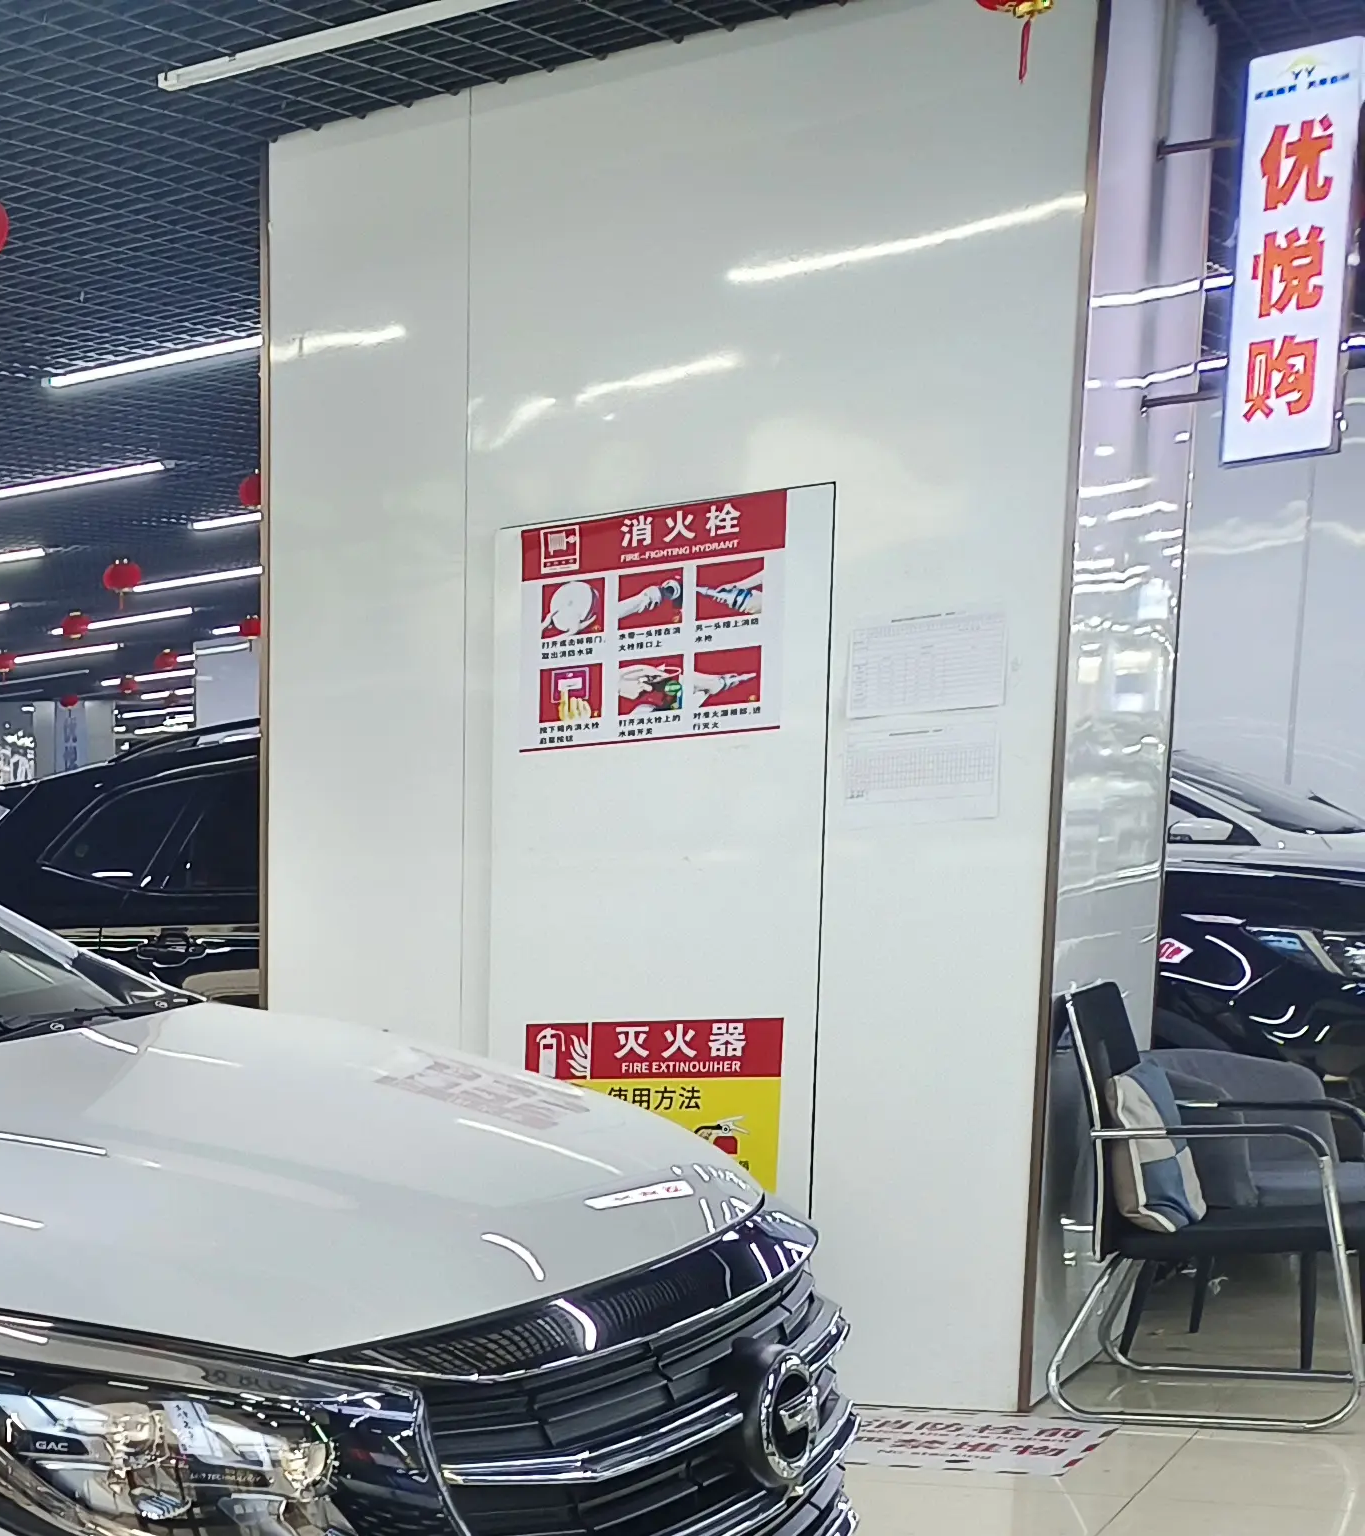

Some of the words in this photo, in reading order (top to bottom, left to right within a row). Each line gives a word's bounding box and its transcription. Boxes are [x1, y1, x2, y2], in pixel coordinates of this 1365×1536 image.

[1242, 114, 1334, 422] 优悦购
[619, 502, 742, 548] 消火栓
[620, 545, 690, 563] FIRE-FIGHTING
[691, 538, 740, 554] HYDRANT
[614, 1022, 747, 1059] 灭火器
[621, 1061, 650, 1074] FIRE
